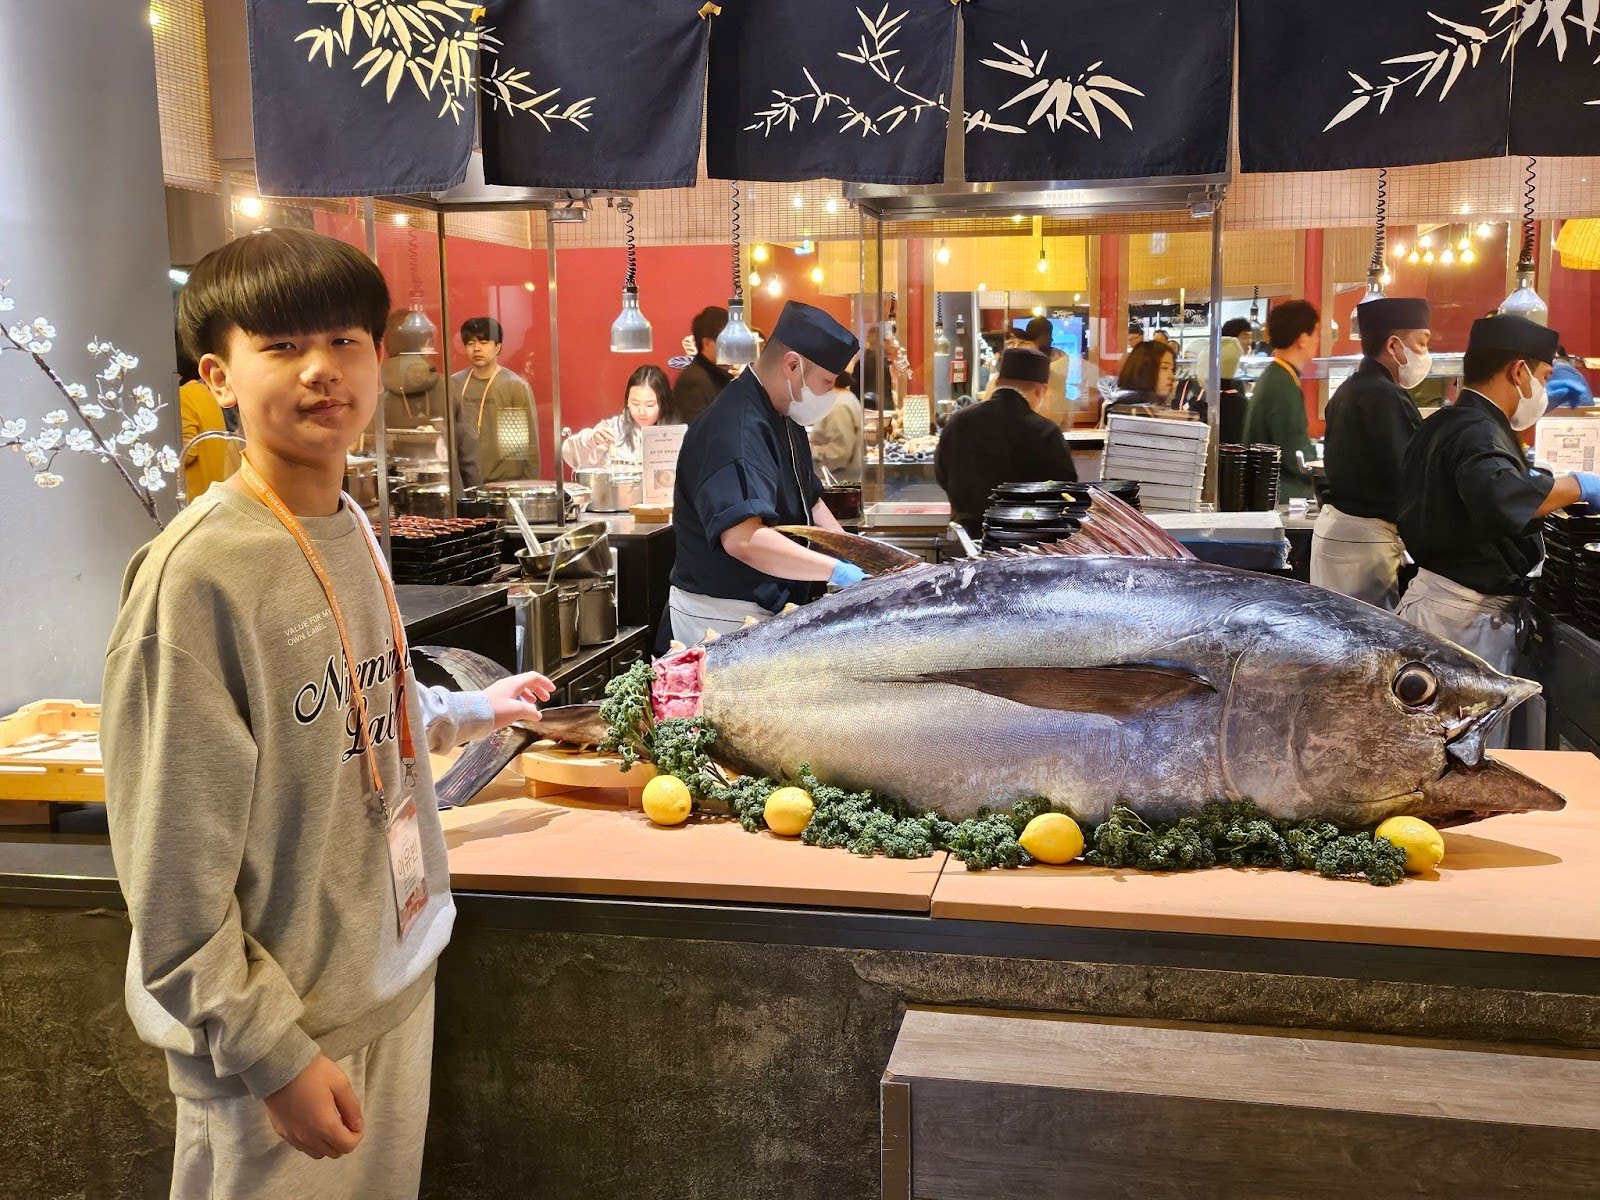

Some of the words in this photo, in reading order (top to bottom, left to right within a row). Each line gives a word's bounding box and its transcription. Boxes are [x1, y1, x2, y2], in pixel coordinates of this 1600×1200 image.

[266, 492, 295, 526] Leadership
[294, 526, 314, 555] Sapporo
[284, 619, 309, 637] VALUE
[309, 613, 322, 624] FOR
[322, 607, 332, 617] MY
[287, 632, 306, 646] OWN
[307, 622, 328, 637] LABEL
